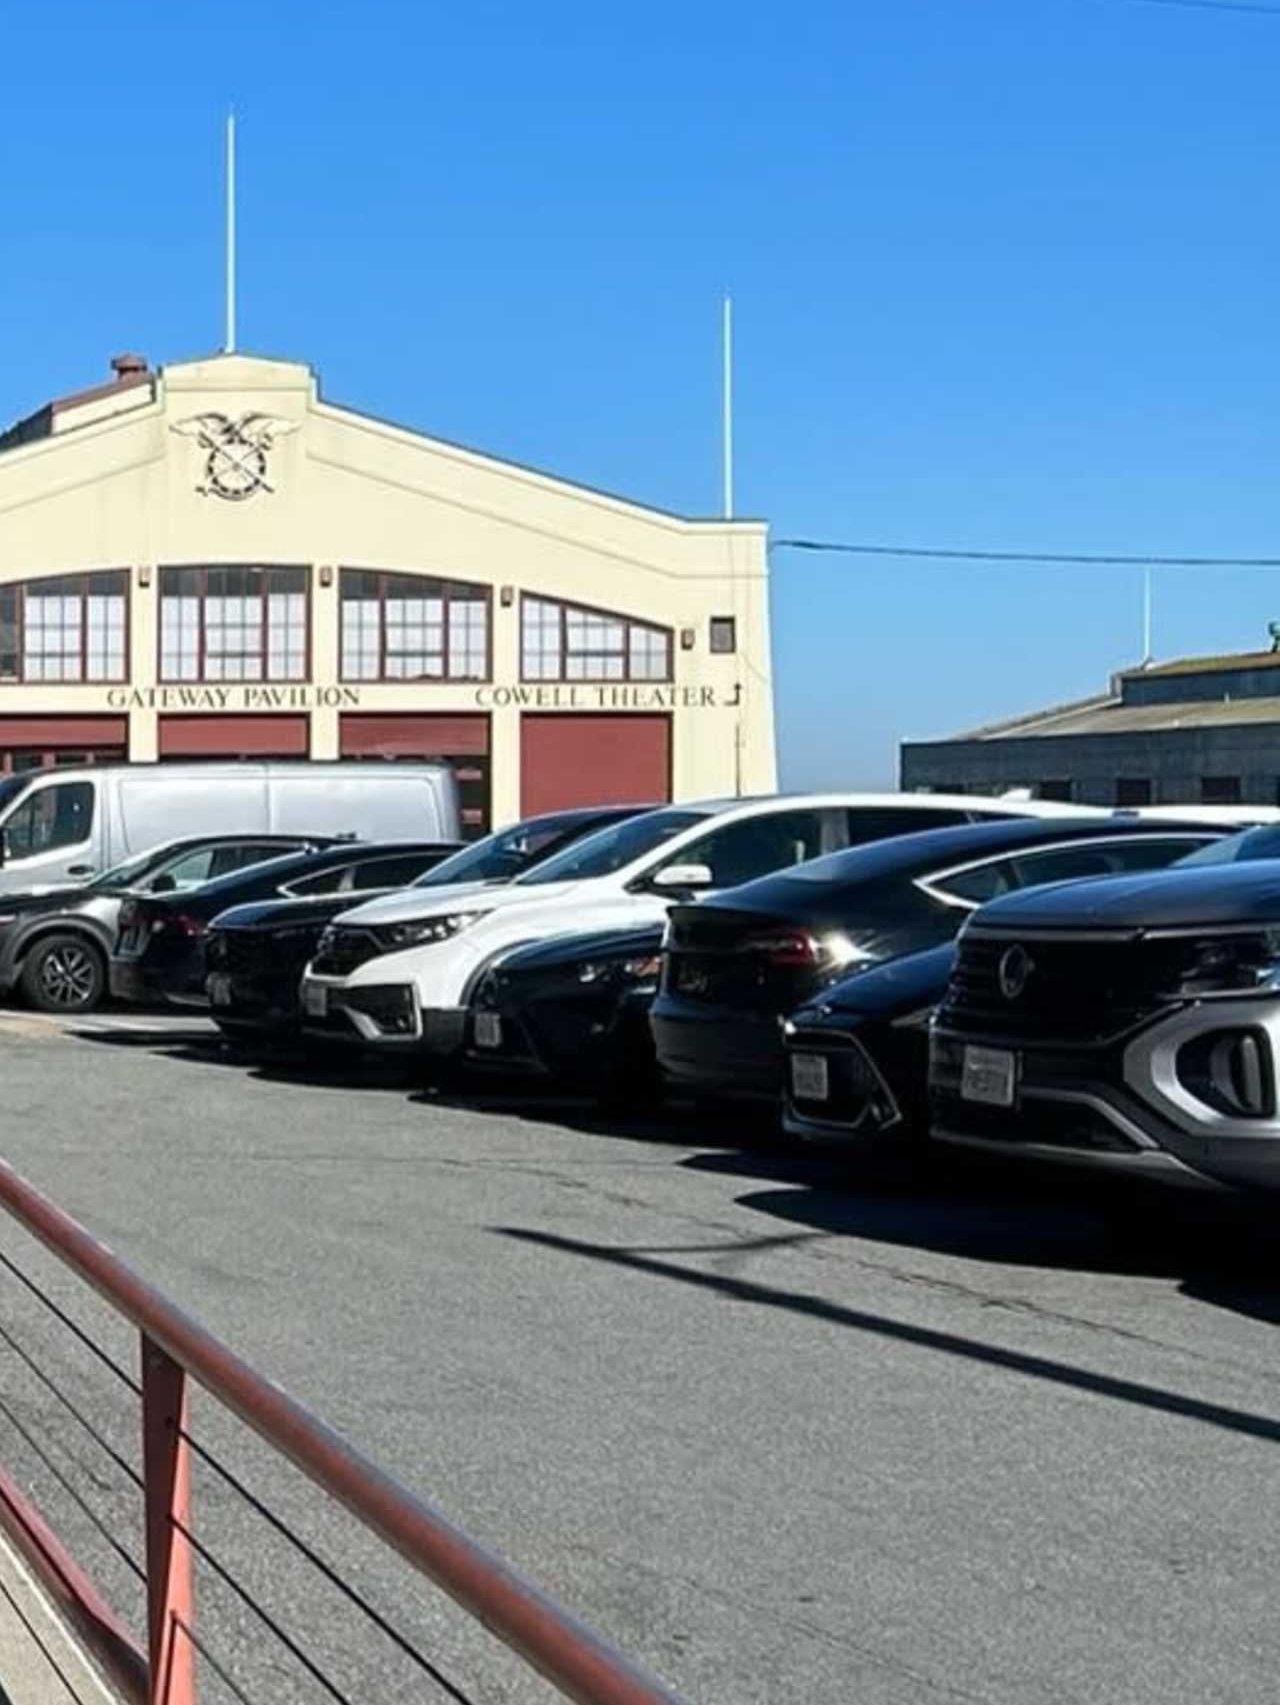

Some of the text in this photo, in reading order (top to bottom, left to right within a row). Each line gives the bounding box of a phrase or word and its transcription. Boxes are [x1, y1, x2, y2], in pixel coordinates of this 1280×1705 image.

[106, 687, 361, 709] GATEWAY PAVILION
[473, 685, 717, 708] COWELL THEATER
